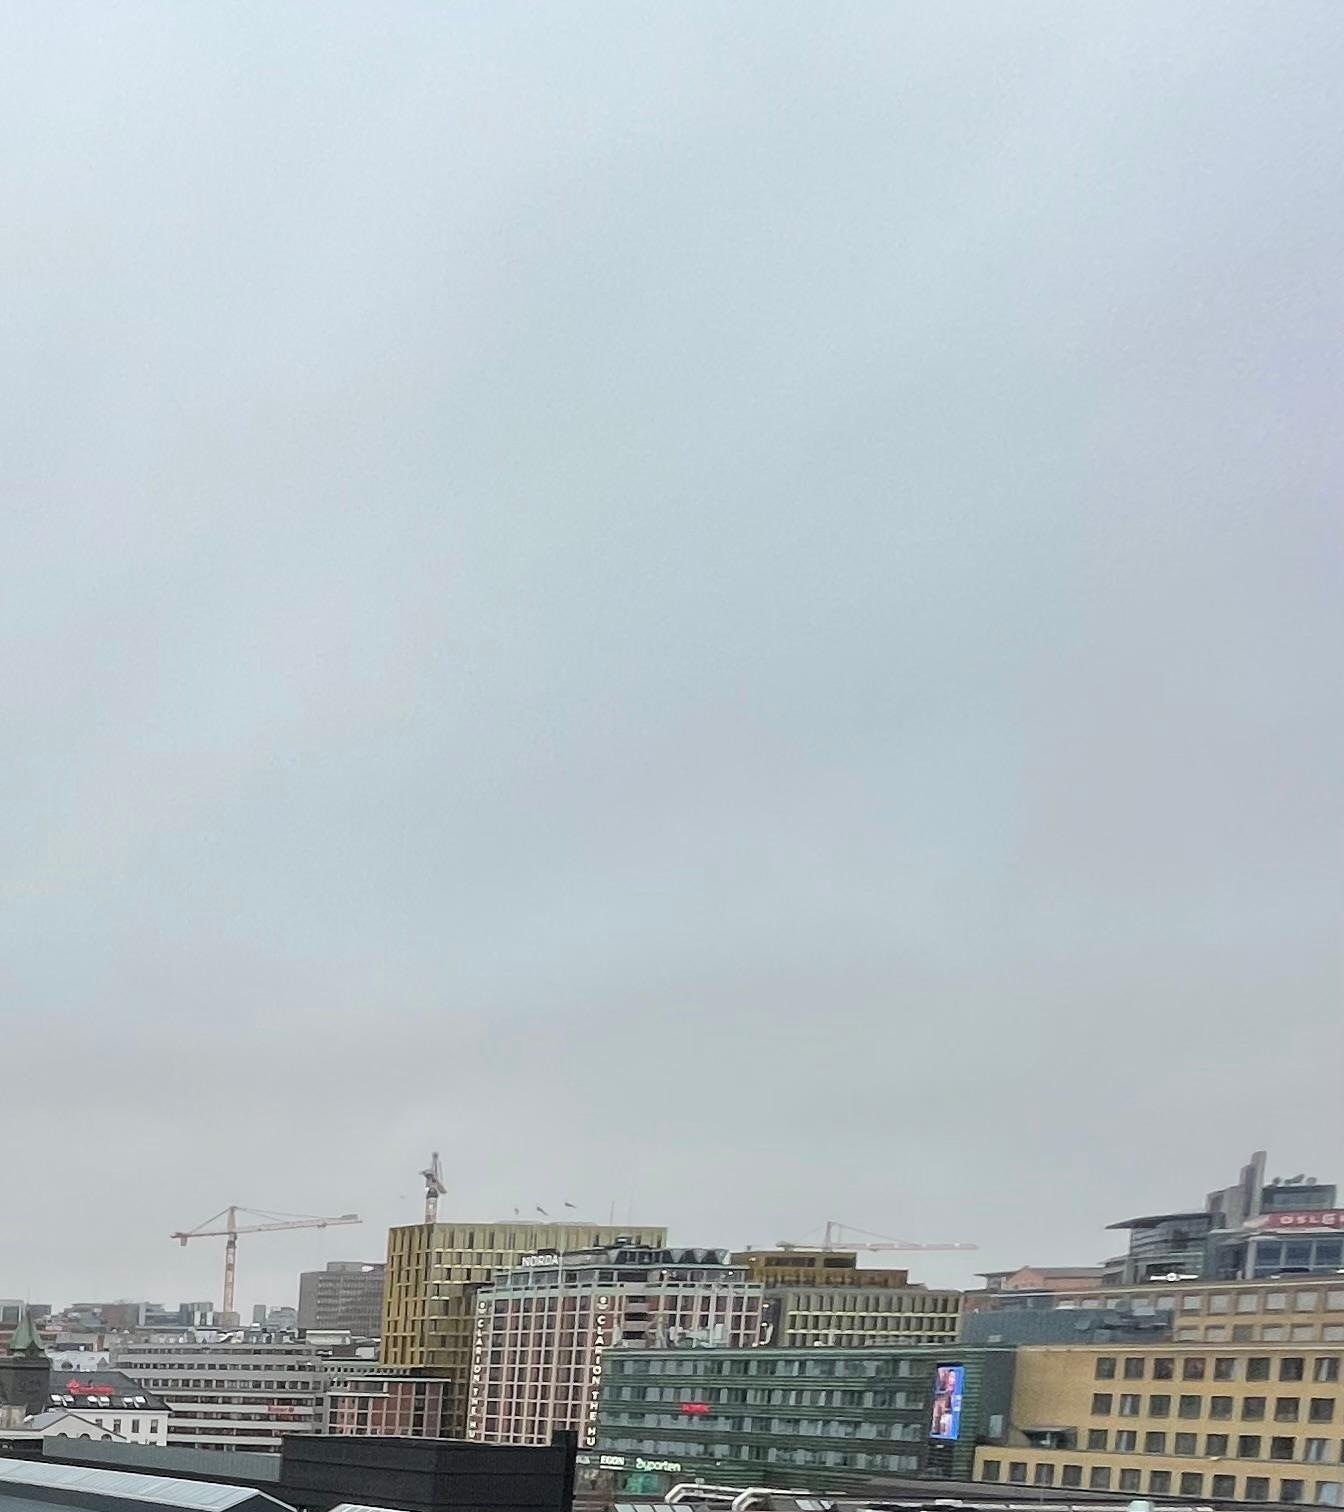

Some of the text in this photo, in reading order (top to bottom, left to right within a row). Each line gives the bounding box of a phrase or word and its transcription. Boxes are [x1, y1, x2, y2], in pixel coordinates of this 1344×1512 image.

[473, 1319, 484, 1382] CLARION
[592, 1315, 606, 1385] CLARION
[471, 1388, 479, 1416] THE
[589, 1391, 599, 1420] THE
